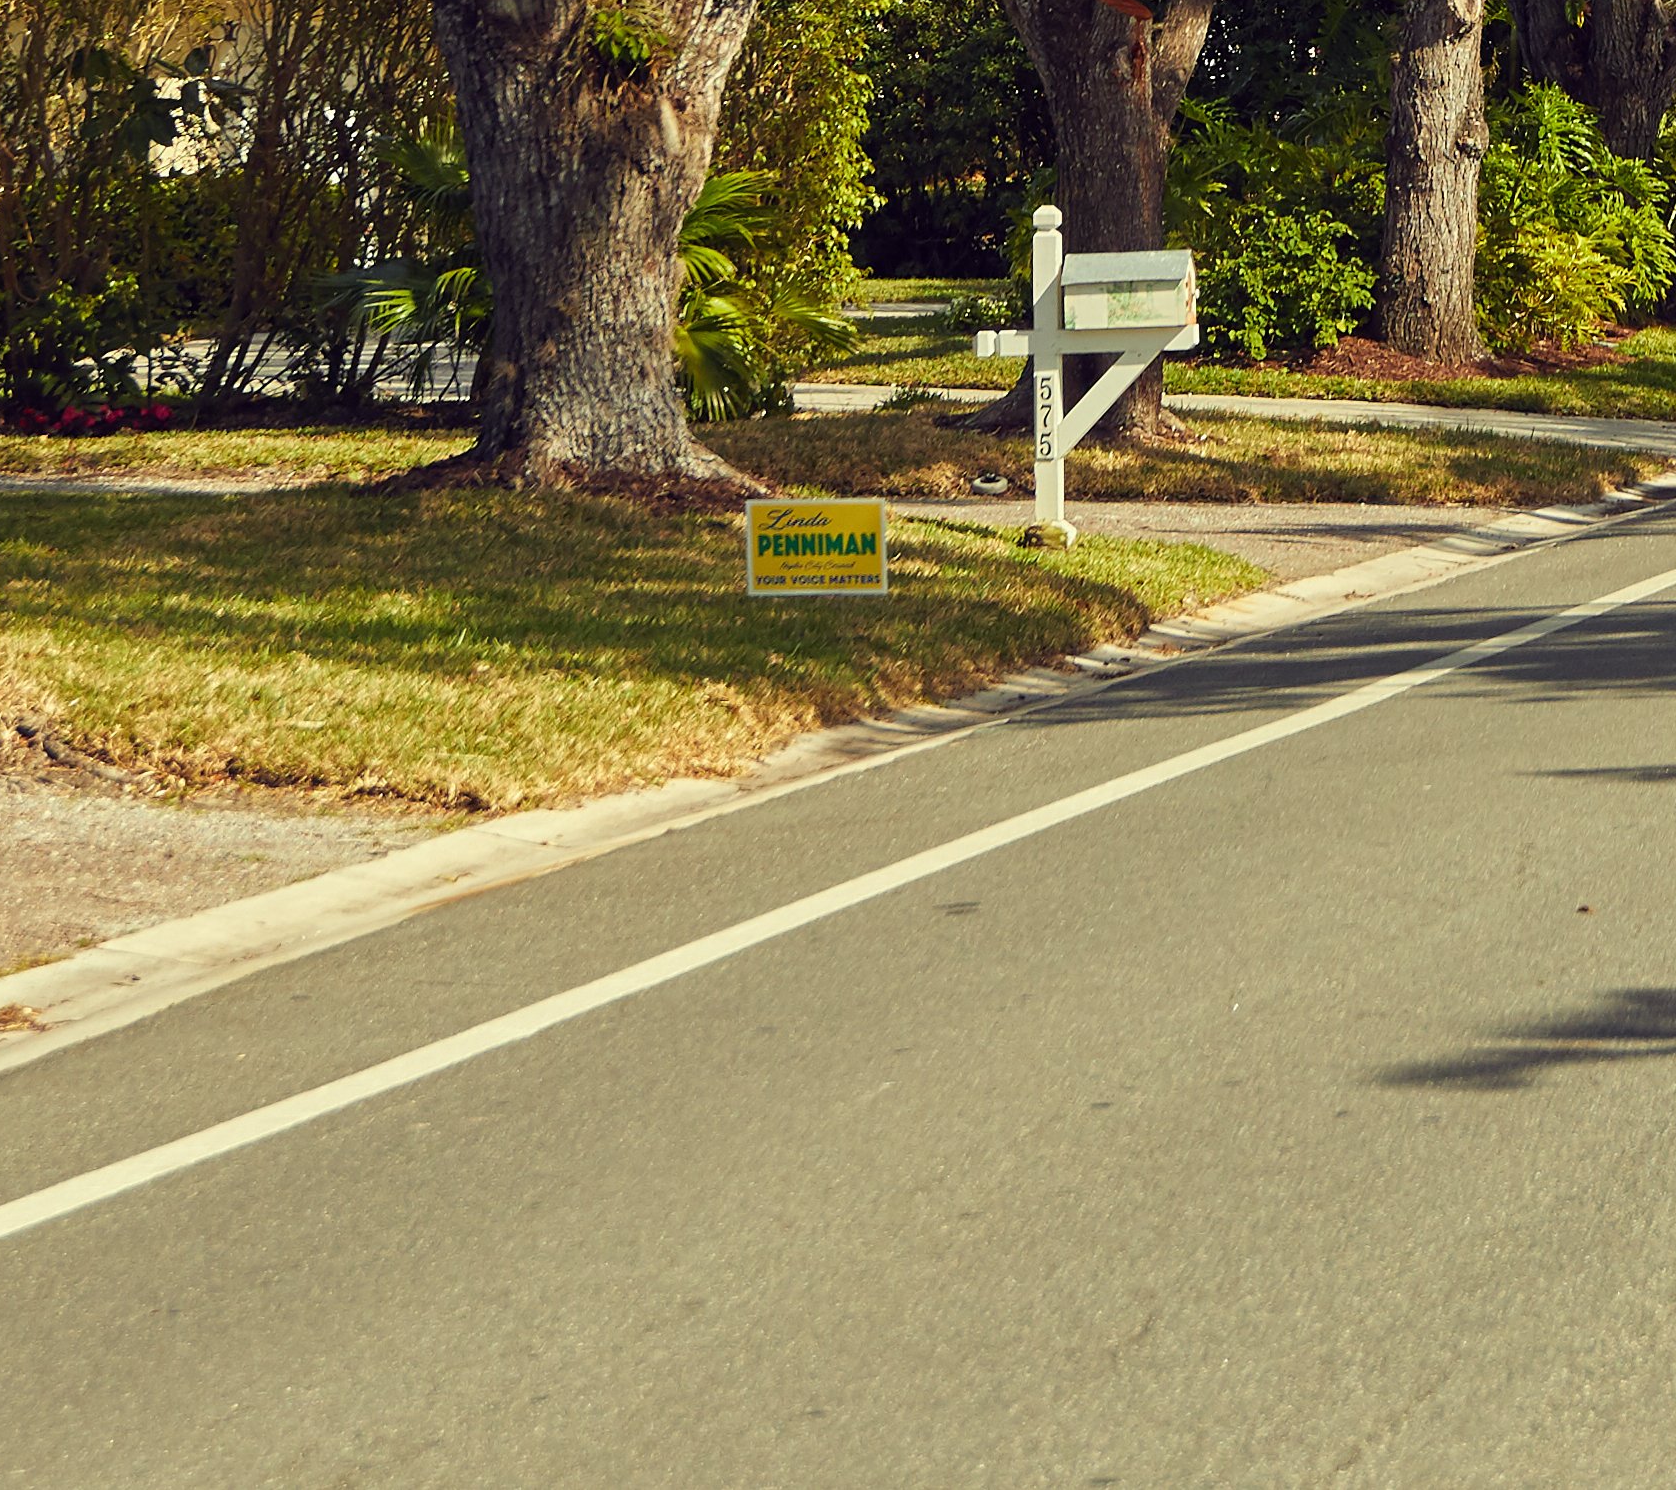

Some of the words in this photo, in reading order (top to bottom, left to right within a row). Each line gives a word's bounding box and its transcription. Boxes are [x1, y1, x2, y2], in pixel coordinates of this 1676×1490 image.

[1040, 376, 1052, 456] 575
[759, 507, 832, 531] Linda
[757, 532, 877, 557] PENNIMAN
[756, 575, 786, 585] YOUR
[790, 574, 825, 585] VOICE
[829, 573, 881, 584] MATTERS
